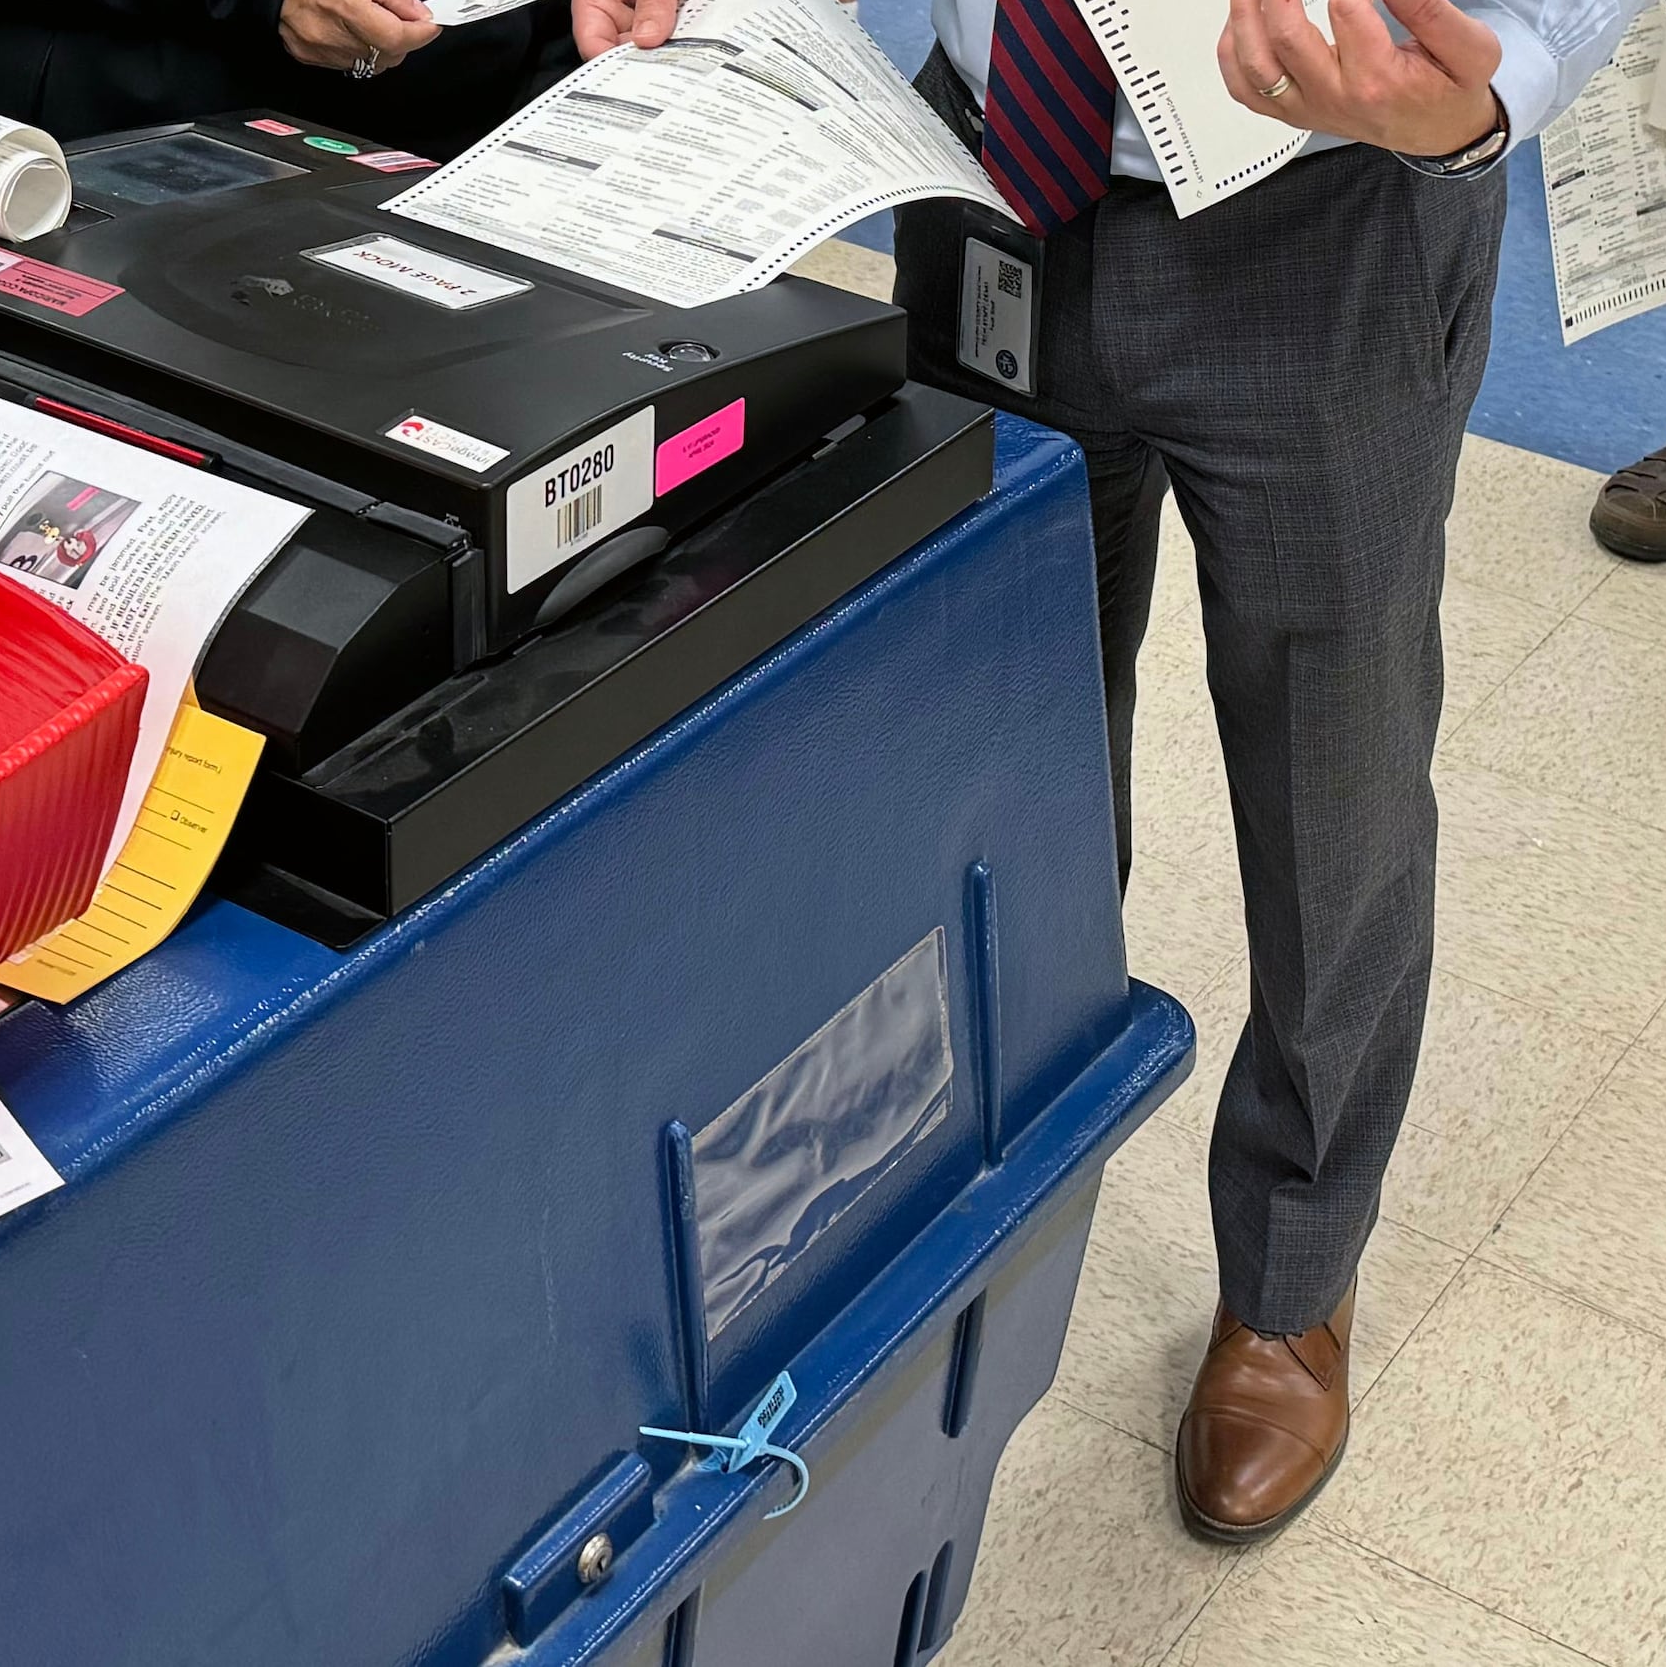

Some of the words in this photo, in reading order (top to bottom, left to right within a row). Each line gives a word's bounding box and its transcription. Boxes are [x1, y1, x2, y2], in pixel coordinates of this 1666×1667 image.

[351, 250, 414, 273] MOCK
[414, 273, 461, 290] PAGE
[459, 287, 476, 296] 2
[544, 444, 614, 508] BT0280
[0, 494, 14, 510] pull
[11, 481, 25, 495] the
[98, 574, 110, 586] be
[101, 602, 118, 620] and
[135, 550, 149, 566] the
[114, 575, 146, 616] RESULTS
[141, 548, 163, 575] HAVE
[149, 584, 162, 599] the
[94, 596, 109, 614] two
[106, 574, 122, 592] poll
